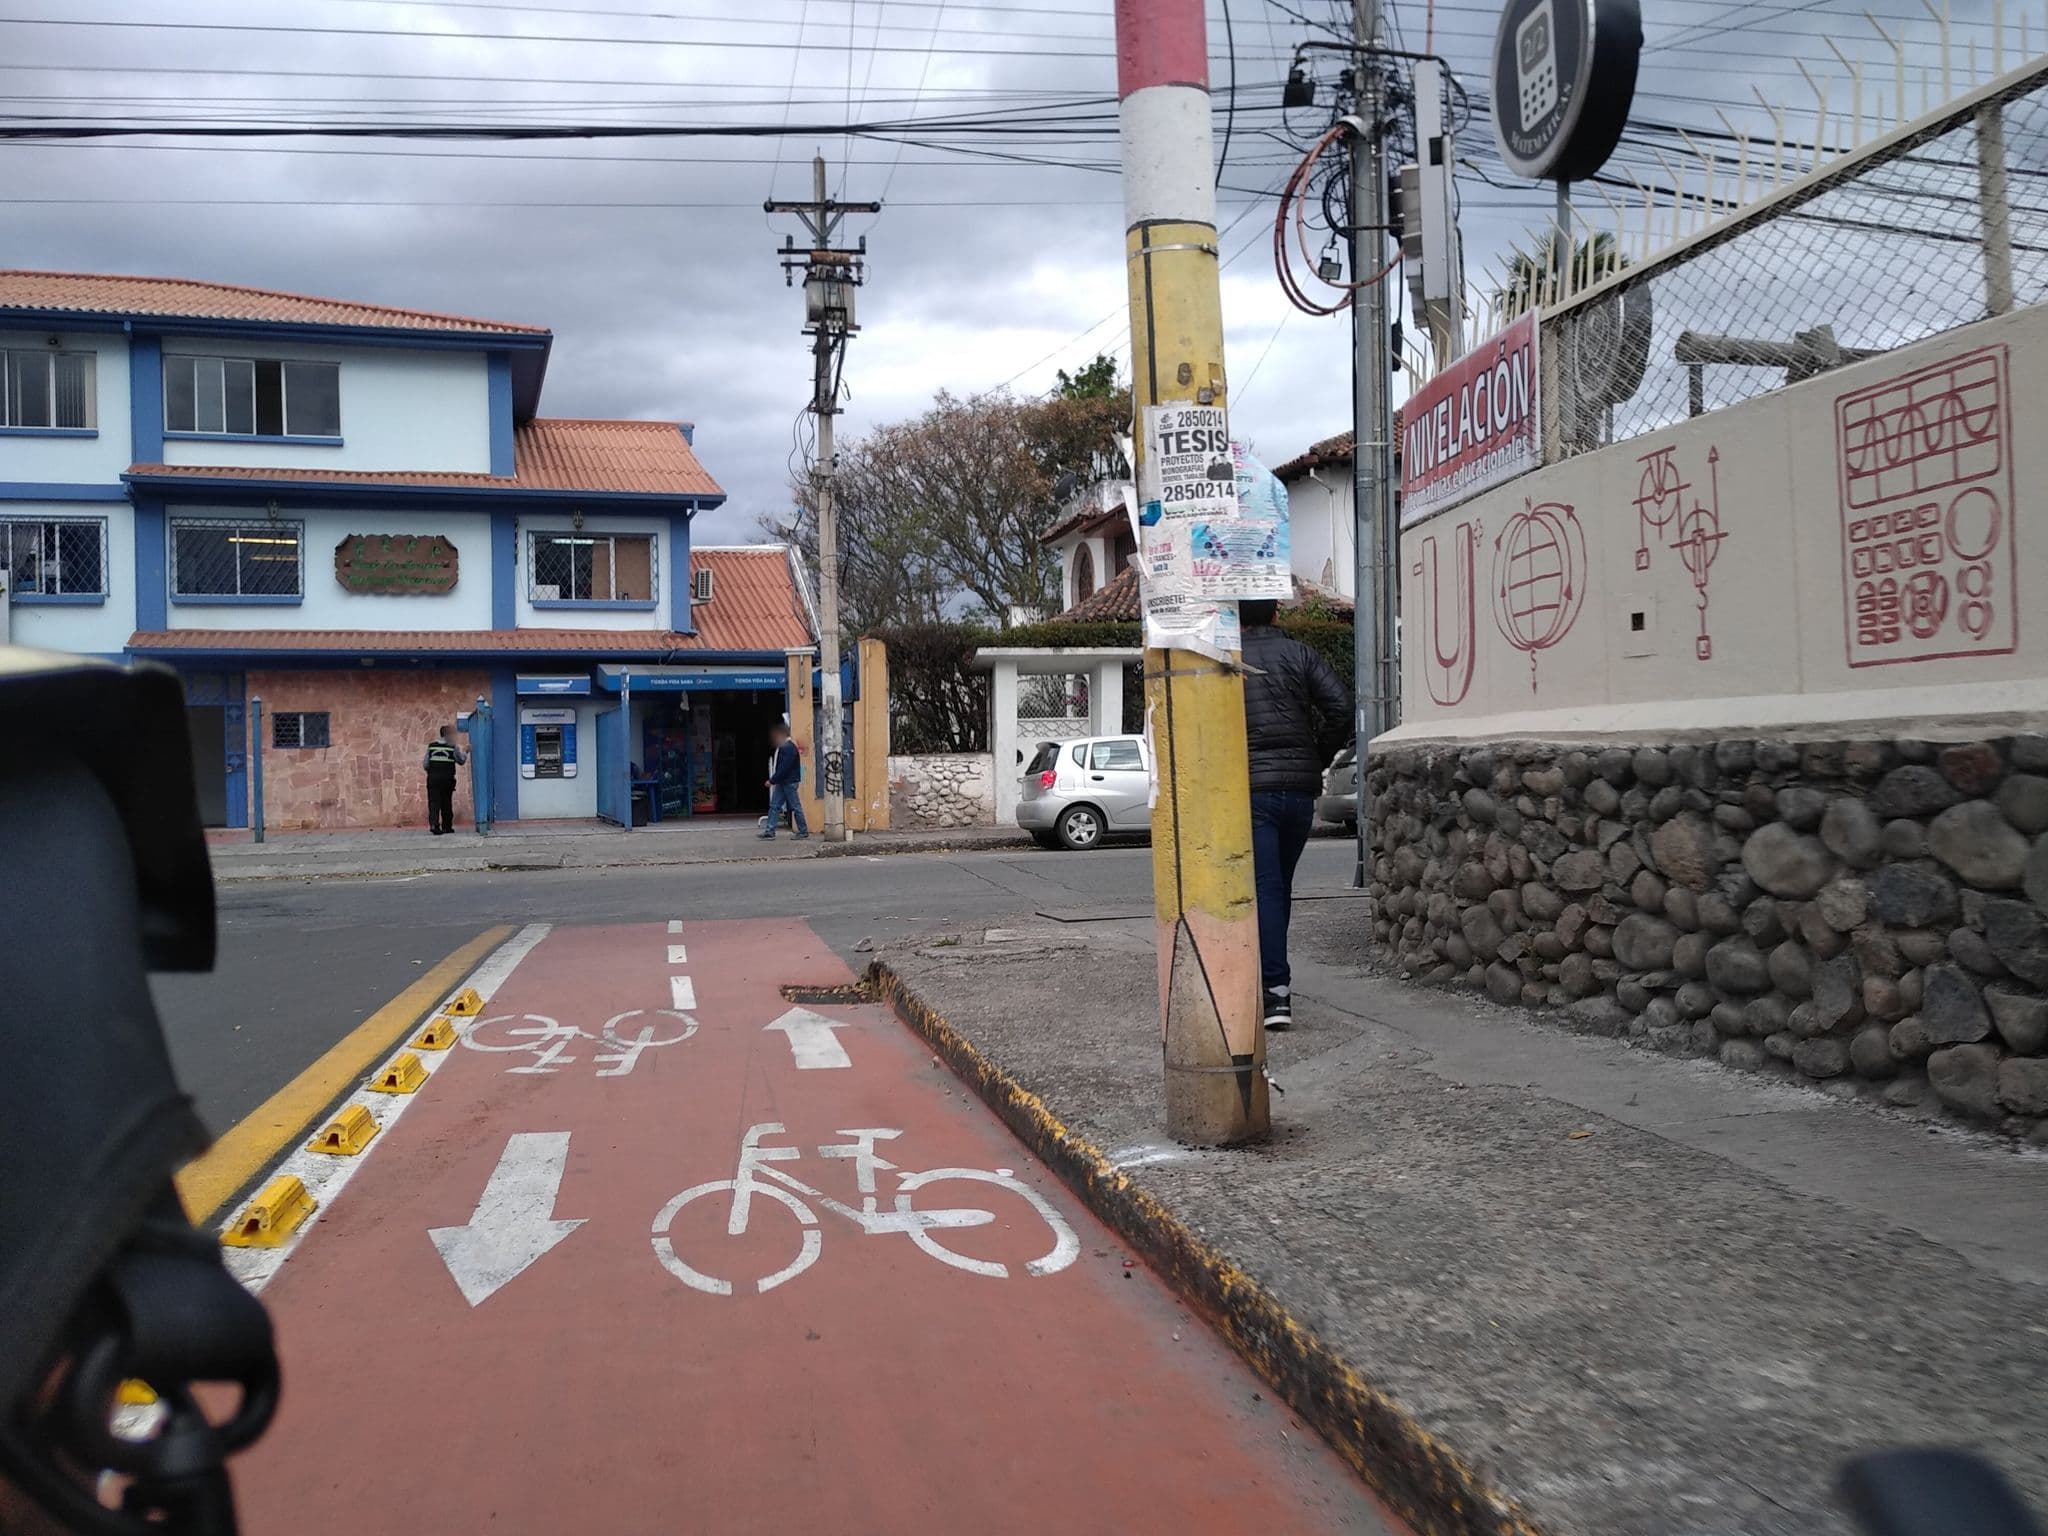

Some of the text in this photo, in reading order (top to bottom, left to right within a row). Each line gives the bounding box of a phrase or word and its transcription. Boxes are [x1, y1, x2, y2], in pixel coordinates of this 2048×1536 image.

[1177, 410, 1222, 428] 2850214
[1409, 340, 1530, 482] NIVELACIÓN
[1158, 429, 1228, 456] TESIS
[1160, 453, 1204, 467] PROYECTOS
[1452, 434, 1529, 488] educacionales
[1163, 482, 1235, 503] 2850214
